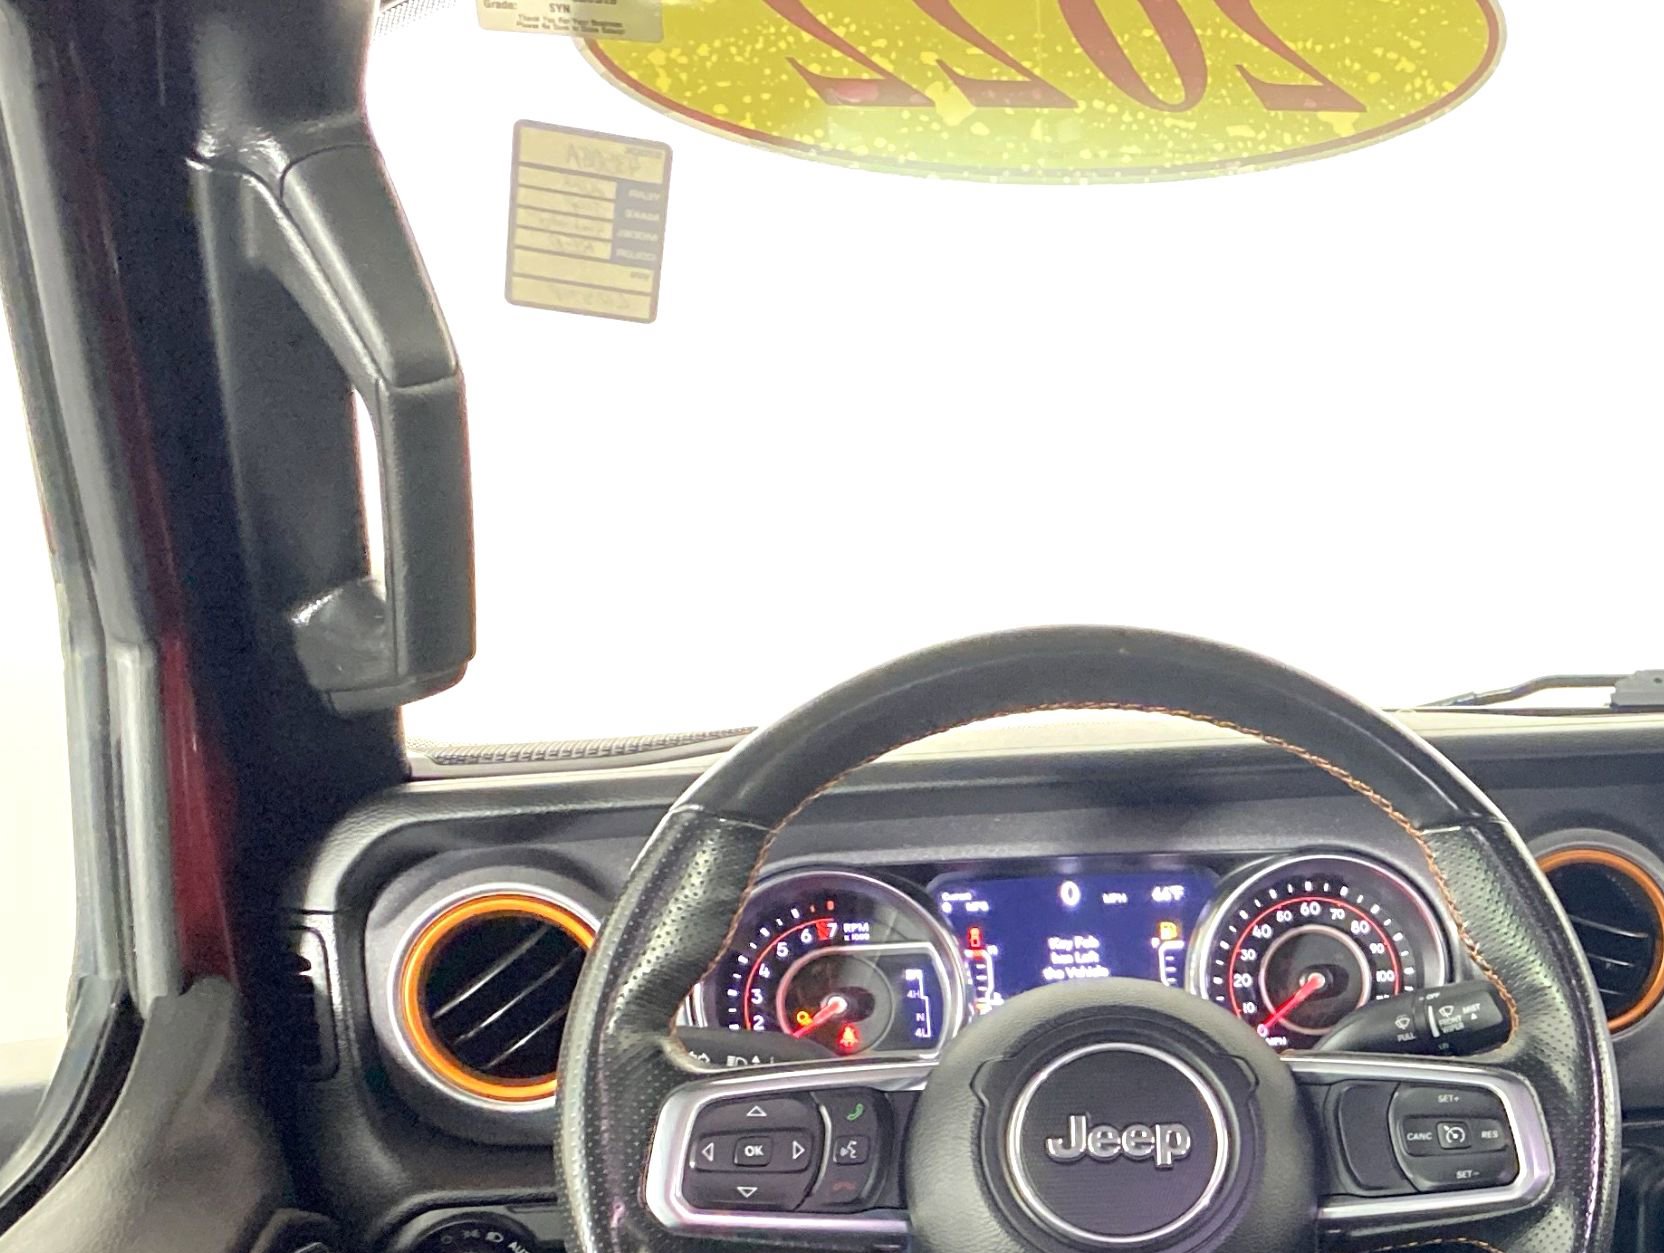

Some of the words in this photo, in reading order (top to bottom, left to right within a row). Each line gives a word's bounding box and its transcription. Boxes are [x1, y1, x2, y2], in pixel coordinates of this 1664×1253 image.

[550, 4, 571, 13] SYN
[1060, 880, 1081, 907] 0
[1103, 892, 1128, 905] MPH
[1300, 901, 1321, 916] 60
[1330, 908, 1346, 920] 70
[1276, 910, 1293, 922] 50
[826, 922, 838, 939] 7
[844, 922, 870, 933] RPM
[1252, 923, 1273, 939] 40
[1350, 919, 1370, 935] 80
[801, 927, 812, 943] 6
[776, 942, 789, 957] 5
[1240, 948, 1257, 961] 30
[1369, 942, 1385, 955] 90
[758, 962, 770, 979] 4
[1376, 969, 1395, 982] 100
[1233, 973, 1252, 988] 20
[751, 987, 763, 1004] 3
[1242, 1001, 1257, 1014] 10
[1462, 1003, 1480, 1014] MIST
[752, 1014, 765, 1031] 2
[916, 1012, 925, 1022] N
[1257, 1023, 1269, 1037] 0
[1266, 1037, 1288, 1047] MPH
[1396, 1032, 1416, 1042] PULL
[1406, 1132, 1433, 1141] CANC
[1481, 1130, 1499, 1139] RES
[1046, 1113, 1192, 1170] Jeep
[744, 1146, 764, 1157] OK
